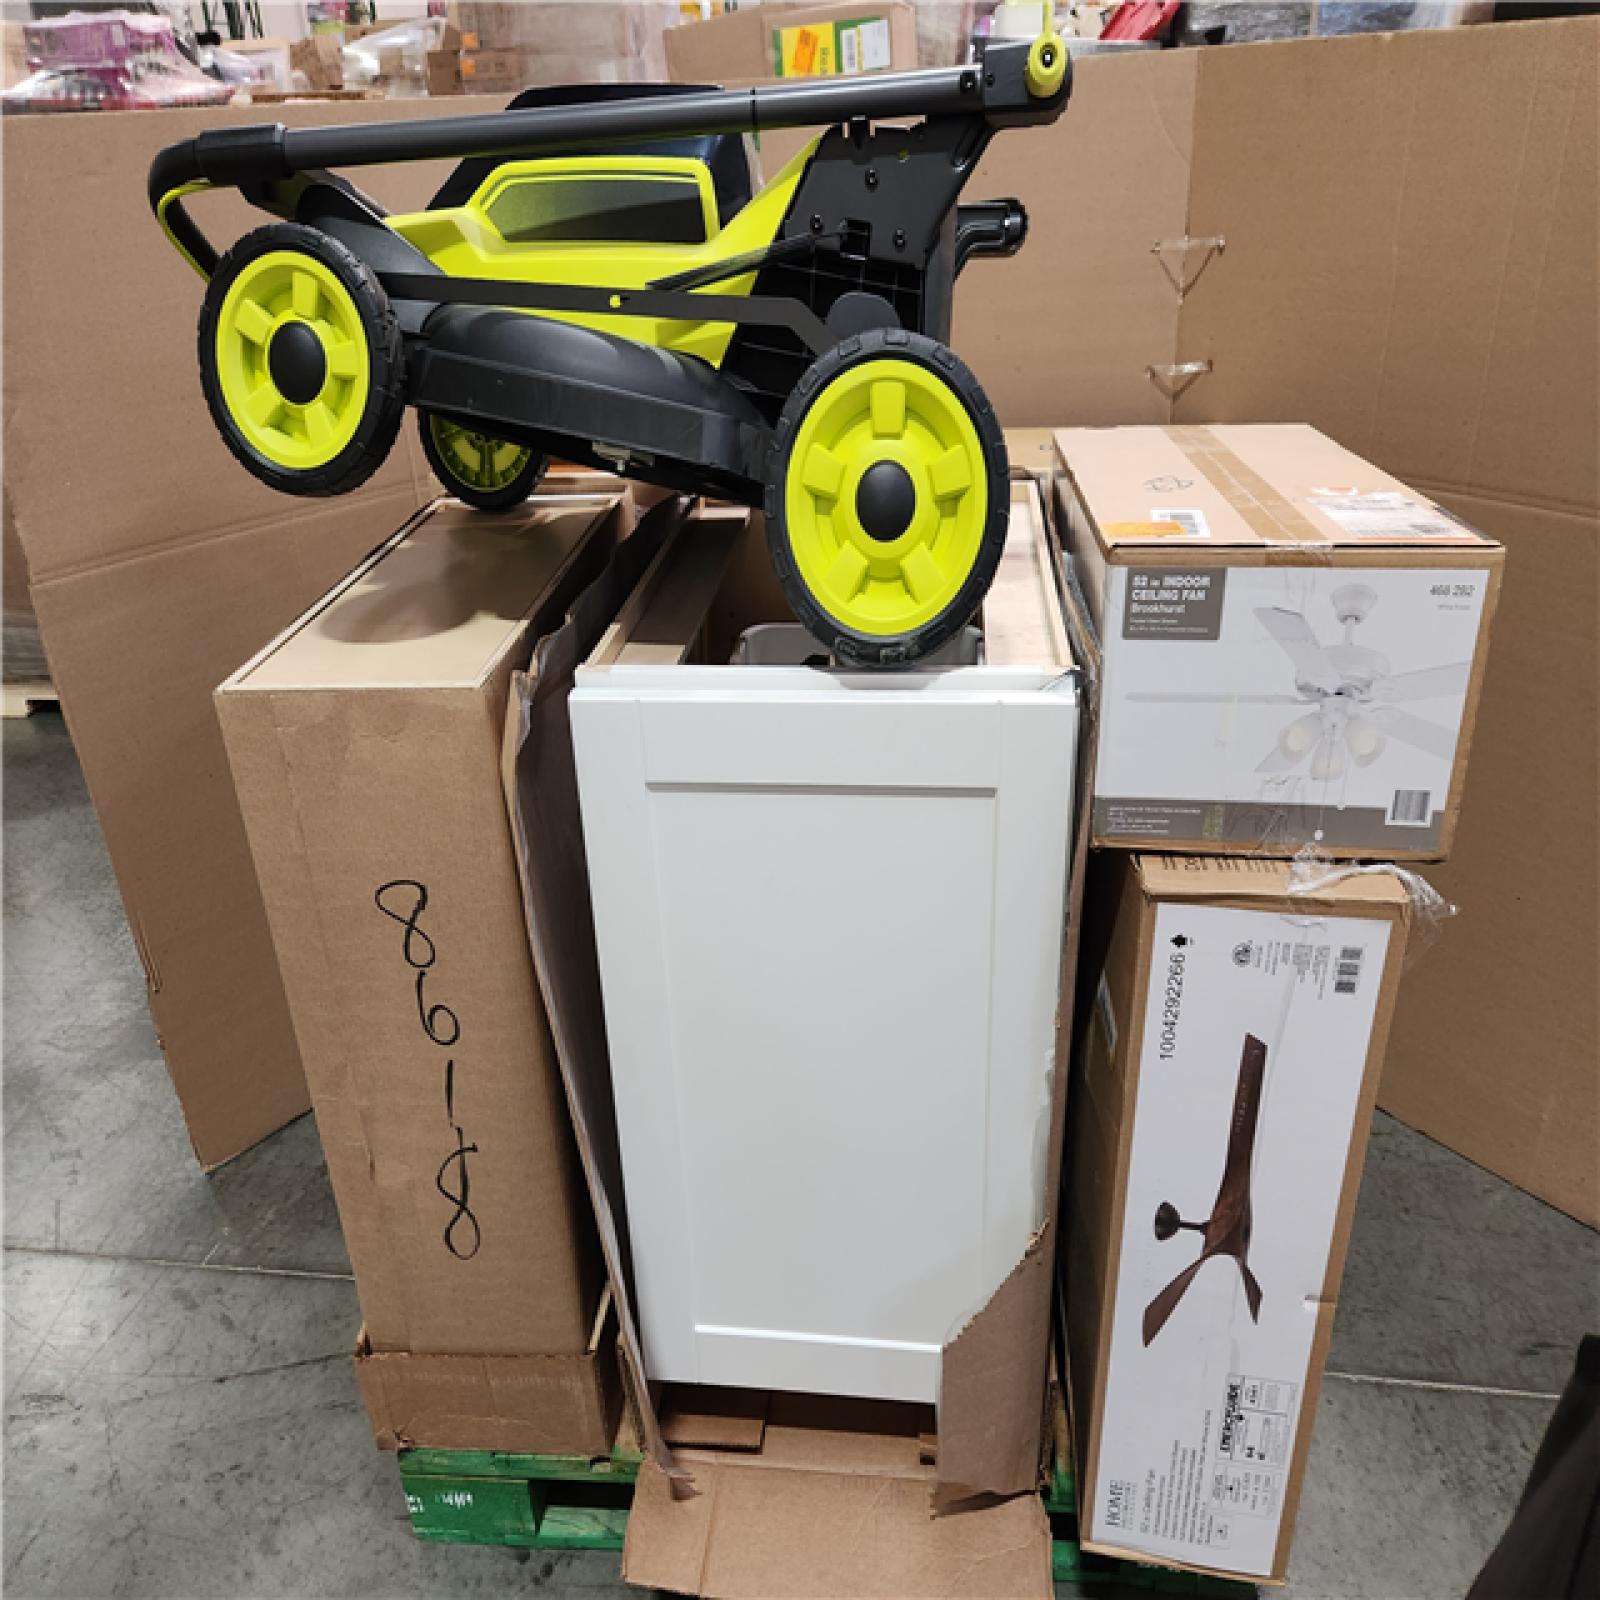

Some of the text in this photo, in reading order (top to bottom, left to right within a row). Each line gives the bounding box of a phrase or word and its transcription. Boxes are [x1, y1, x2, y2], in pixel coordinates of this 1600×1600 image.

[1163, 574, 1211, 588] INDOOR
[1131, 589, 1206, 601] CEILING FAN
[1159, 952, 1187, 1061] 1004292266
